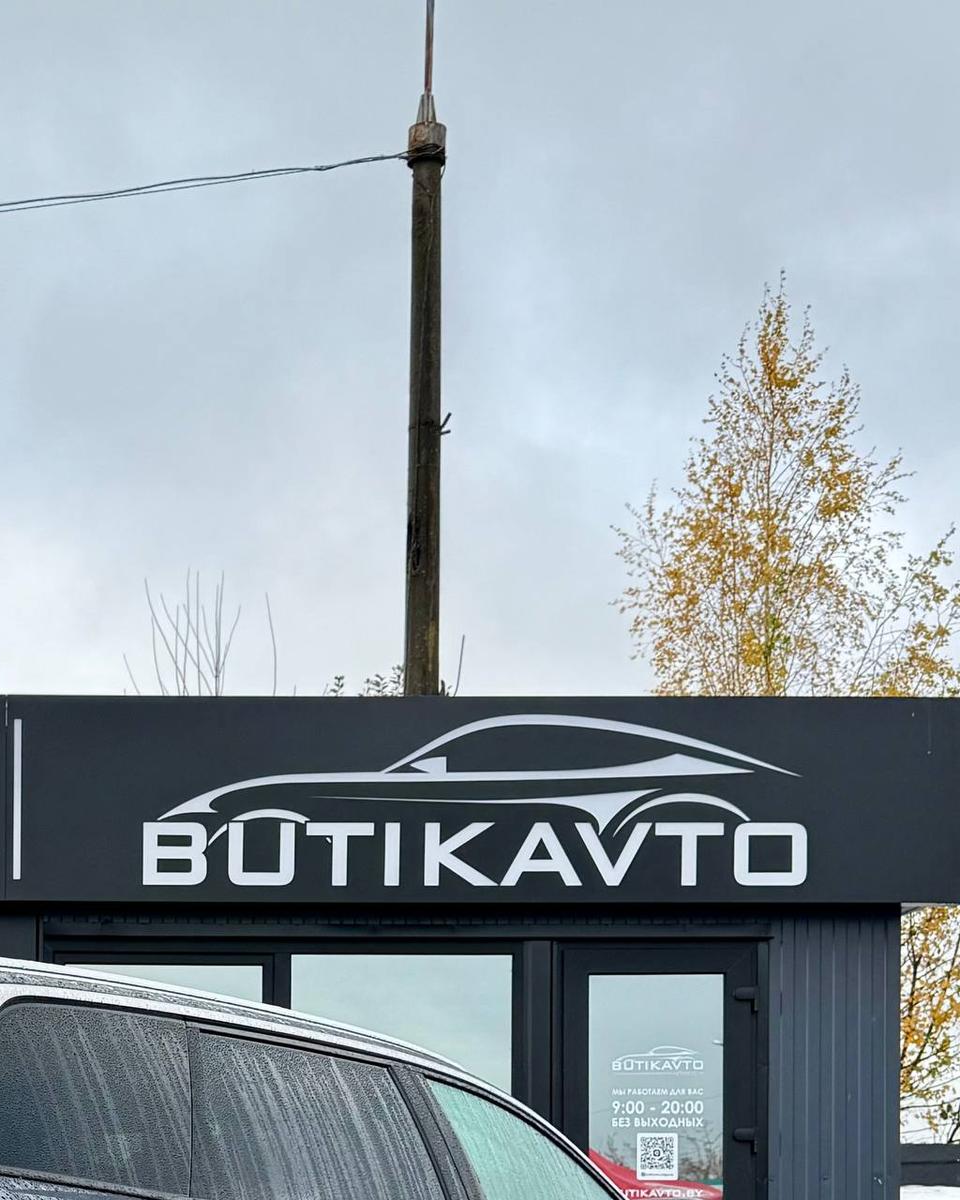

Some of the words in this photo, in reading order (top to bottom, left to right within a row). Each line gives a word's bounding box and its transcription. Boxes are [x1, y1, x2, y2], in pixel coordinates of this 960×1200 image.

[142, 820, 808, 887] BUTIKAVTO
[611, 1059, 704, 1071] BUTIKAVTO
[611, 1088, 626, 1096] МЫ
[687, 1088, 704, 1096] ВАС
[611, 1100, 645, 1114] 9:00
[661, 1100, 704, 1114] 20:00
[611, 1117, 631, 1128] БЕЗ
[634, 1117, 704, 1129] ВЫХОДНЫХ
